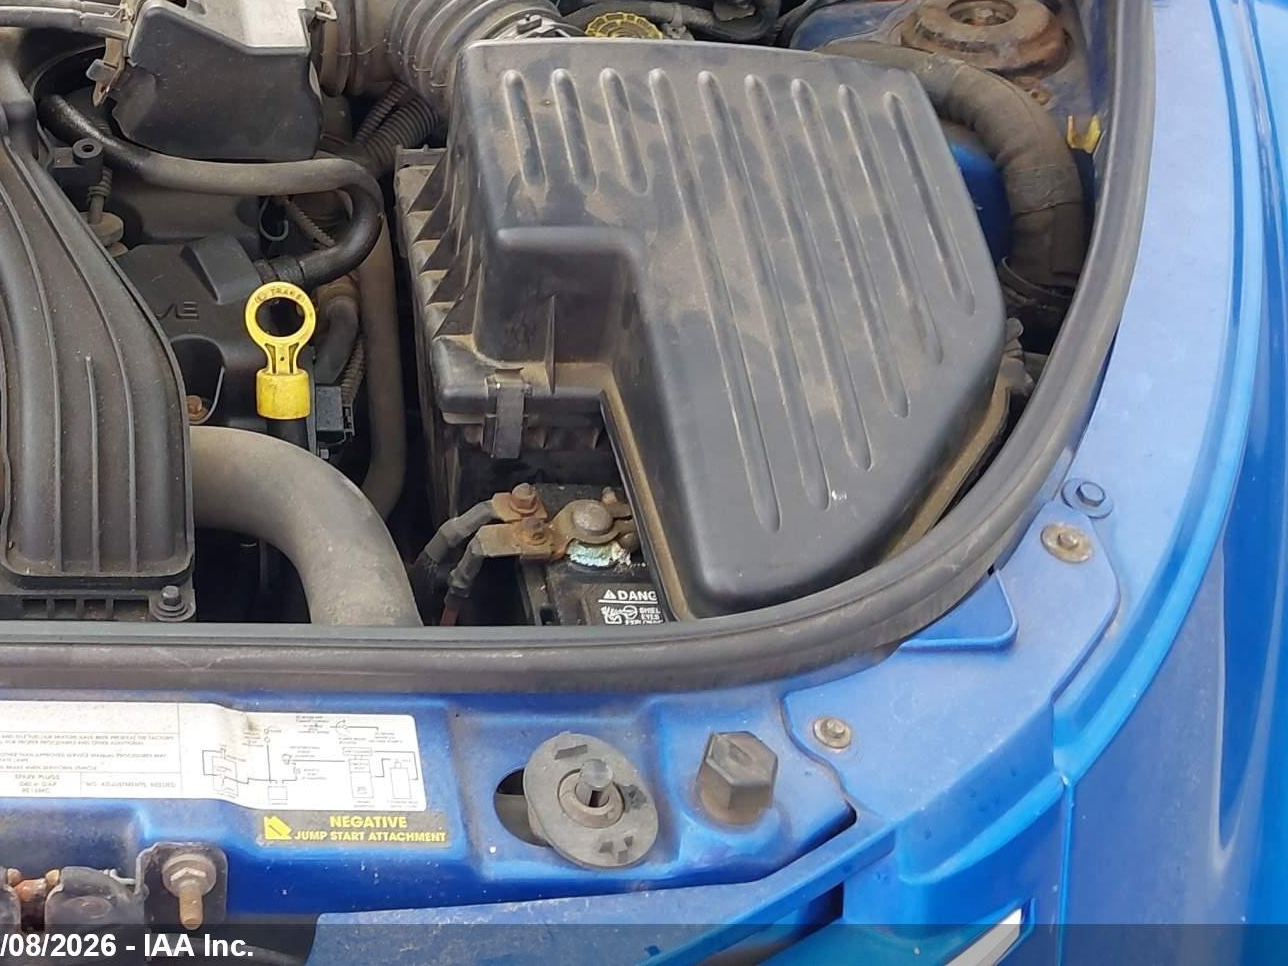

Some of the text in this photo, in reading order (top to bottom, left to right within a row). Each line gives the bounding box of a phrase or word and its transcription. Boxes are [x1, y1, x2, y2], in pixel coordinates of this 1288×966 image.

[328, 815, 408, 829] NEGATIVE
[294, 830, 446, 843] JUMP START ATTACHMENT
